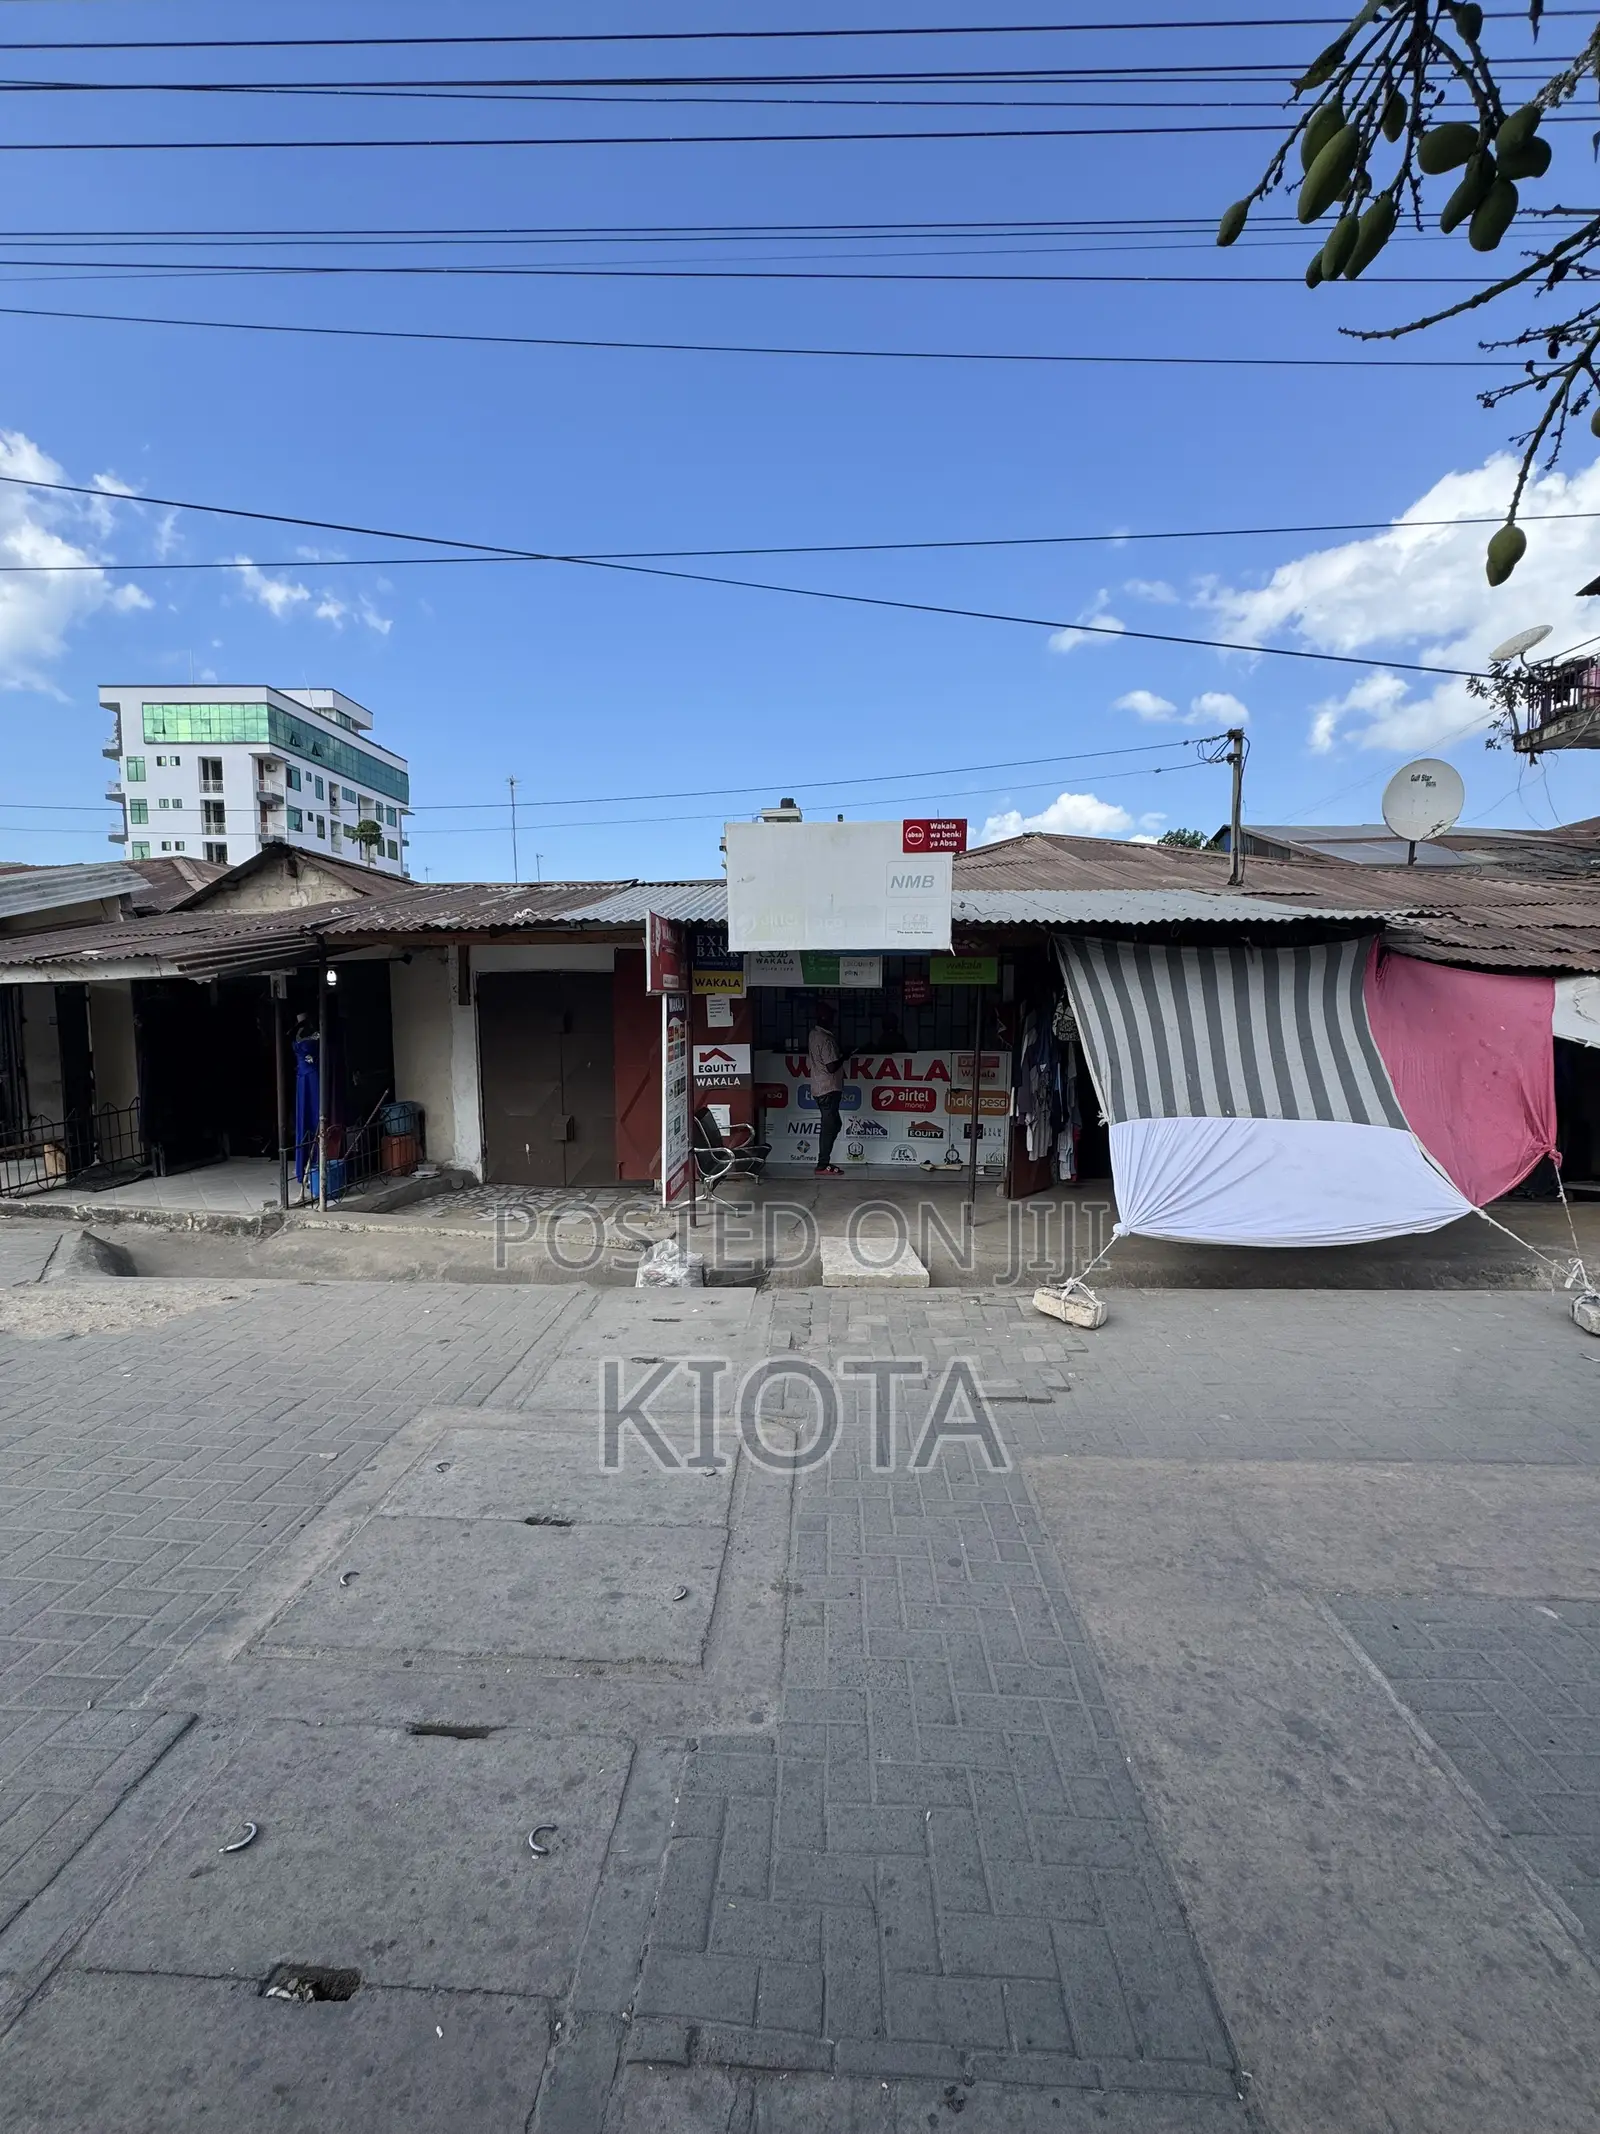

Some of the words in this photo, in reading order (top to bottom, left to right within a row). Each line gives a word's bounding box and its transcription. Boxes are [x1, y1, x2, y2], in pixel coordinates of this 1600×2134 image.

[1421, 774, 1432, 782] Star
[929, 822, 957, 830] Wakala
[929, 840, 938, 848] ya
[890, 875, 935, 889] NMB
[696, 935, 728, 946] EXI
[755, 958, 795, 966] WAKALA
[946, 960, 982, 970] wakala
[694, 978, 741, 988] WAKALA
[698, 1063, 738, 1073] EQUITY
[785, 1056, 951, 1083] WKALA
[961, 1069, 996, 1078] Wala
[696, 1077, 741, 1087] WAKALA
[898, 1088, 929, 1102] airtel
[905, 1102, 927, 1110] money
[865, 1127, 884, 1135] NBC
[909, 1130, 942, 1138] EQUITY
